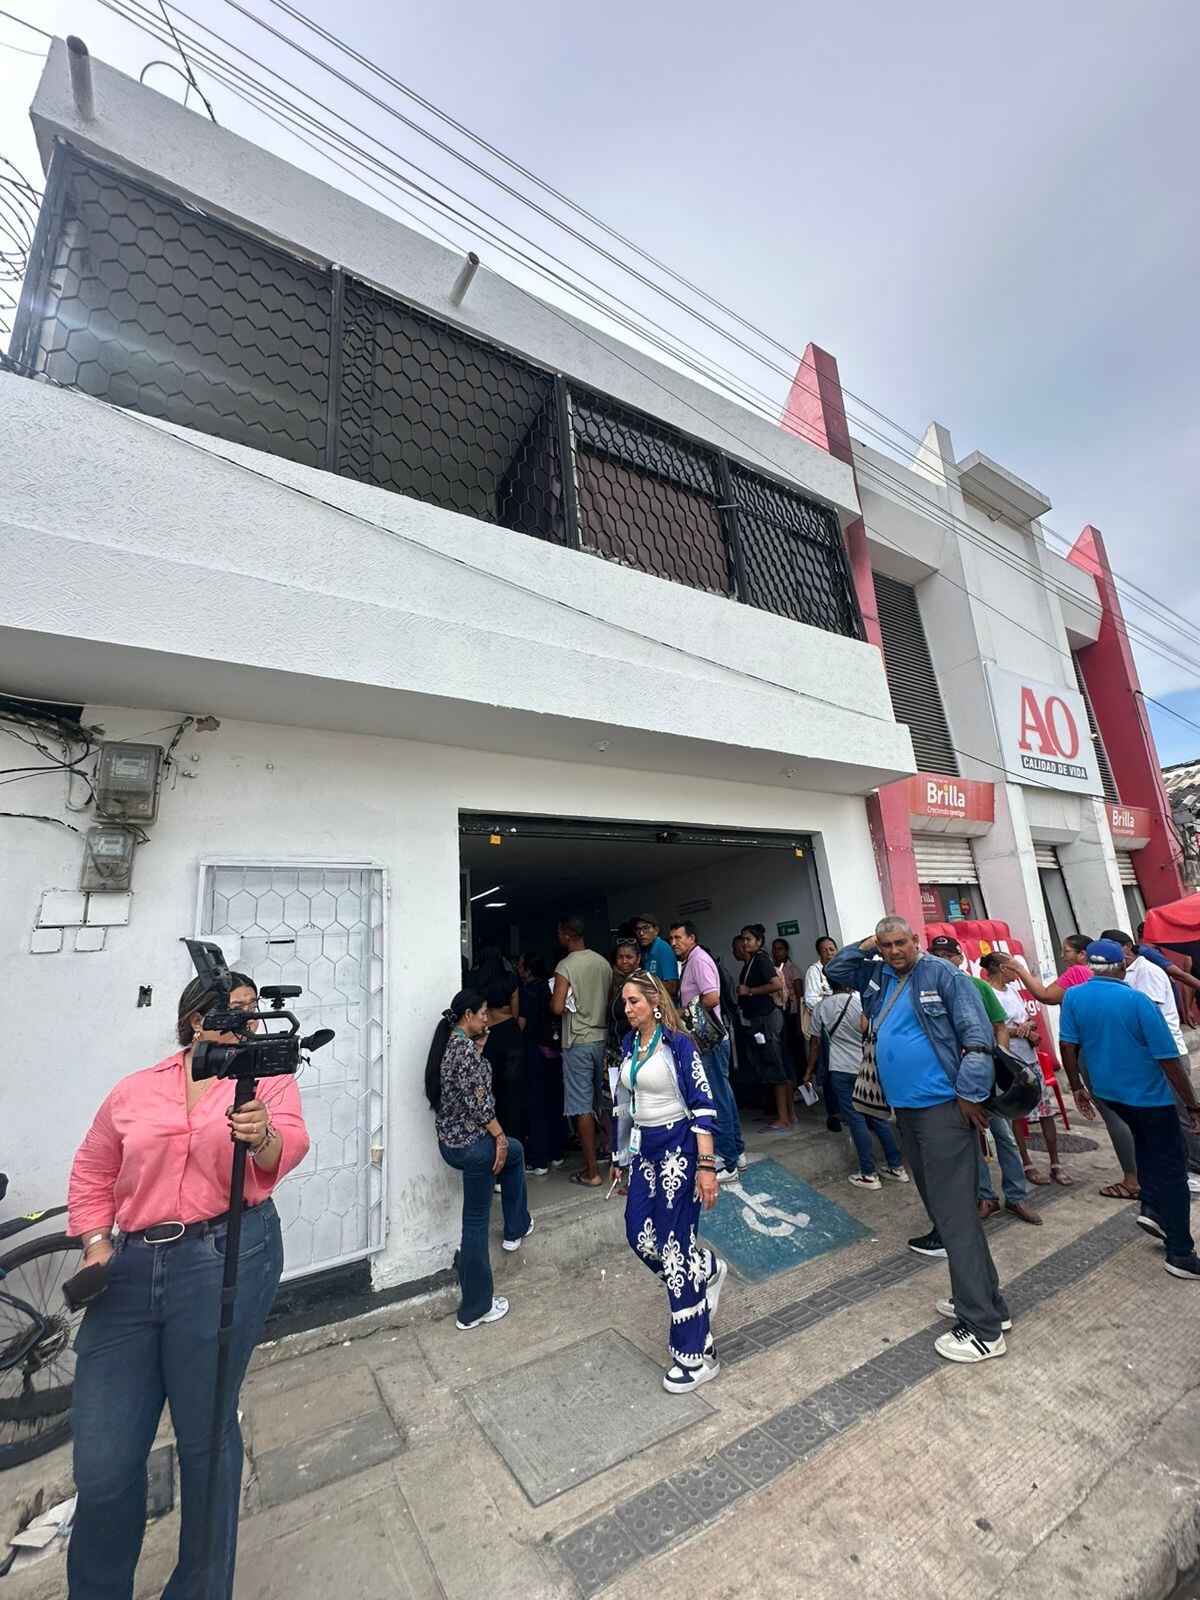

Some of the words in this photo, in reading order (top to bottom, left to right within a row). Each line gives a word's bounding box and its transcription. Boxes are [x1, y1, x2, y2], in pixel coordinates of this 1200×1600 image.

[1018, 686, 1079, 759] AO
[1023, 756, 1057, 773] CALIDAD
[1057, 763, 1069, 775] DE
[1069, 766, 1086, 779] VIDA
[927, 781, 966, 808] Brilla
[1112, 809, 1135, 828] Brilla
